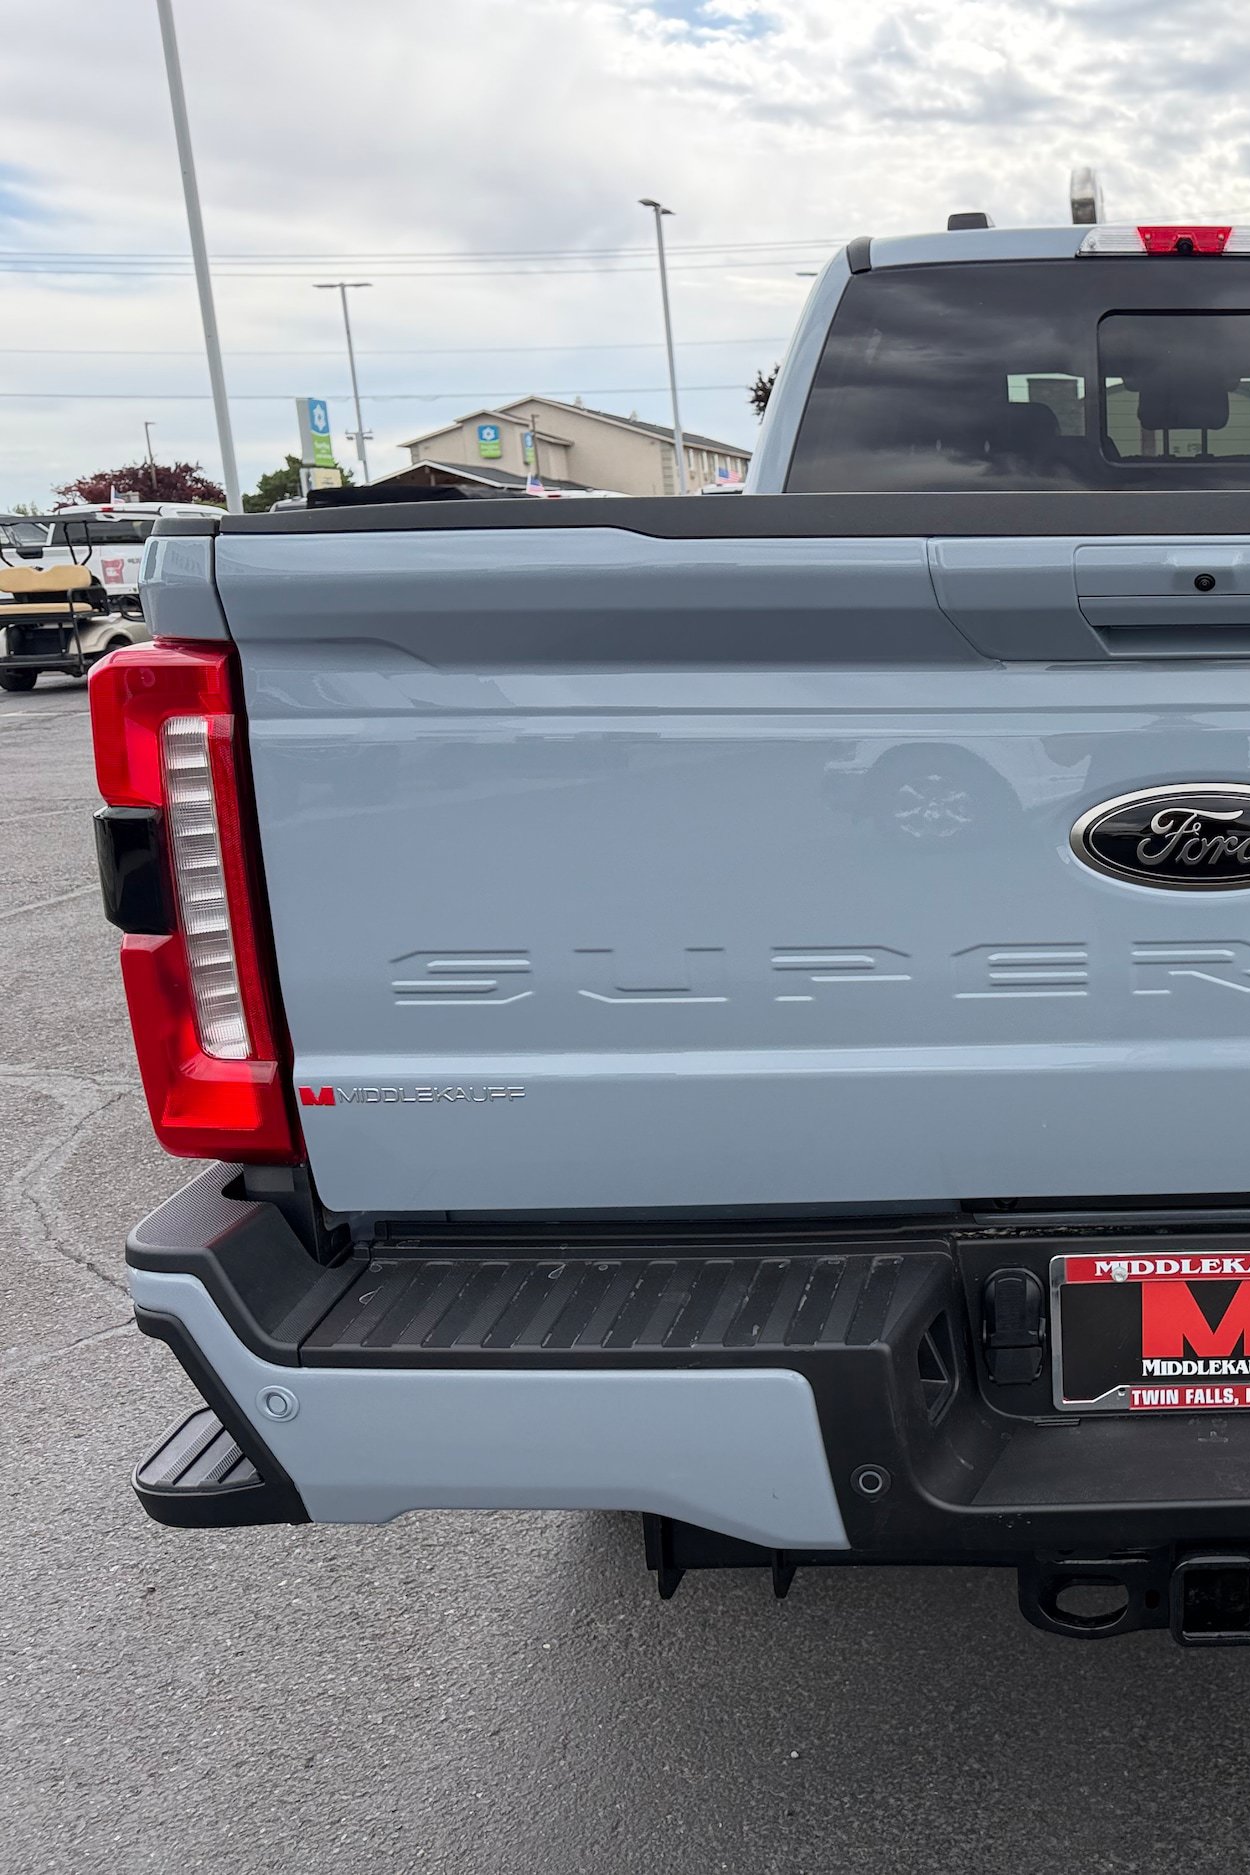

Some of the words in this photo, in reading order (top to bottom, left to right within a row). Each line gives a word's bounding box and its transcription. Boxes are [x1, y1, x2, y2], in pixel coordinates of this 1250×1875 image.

[337, 1086, 526, 1103] MIDDLEKAUFF
[1131, 1388, 1177, 1405] TWIN
[1185, 1387, 1239, 1406] FALLS,
